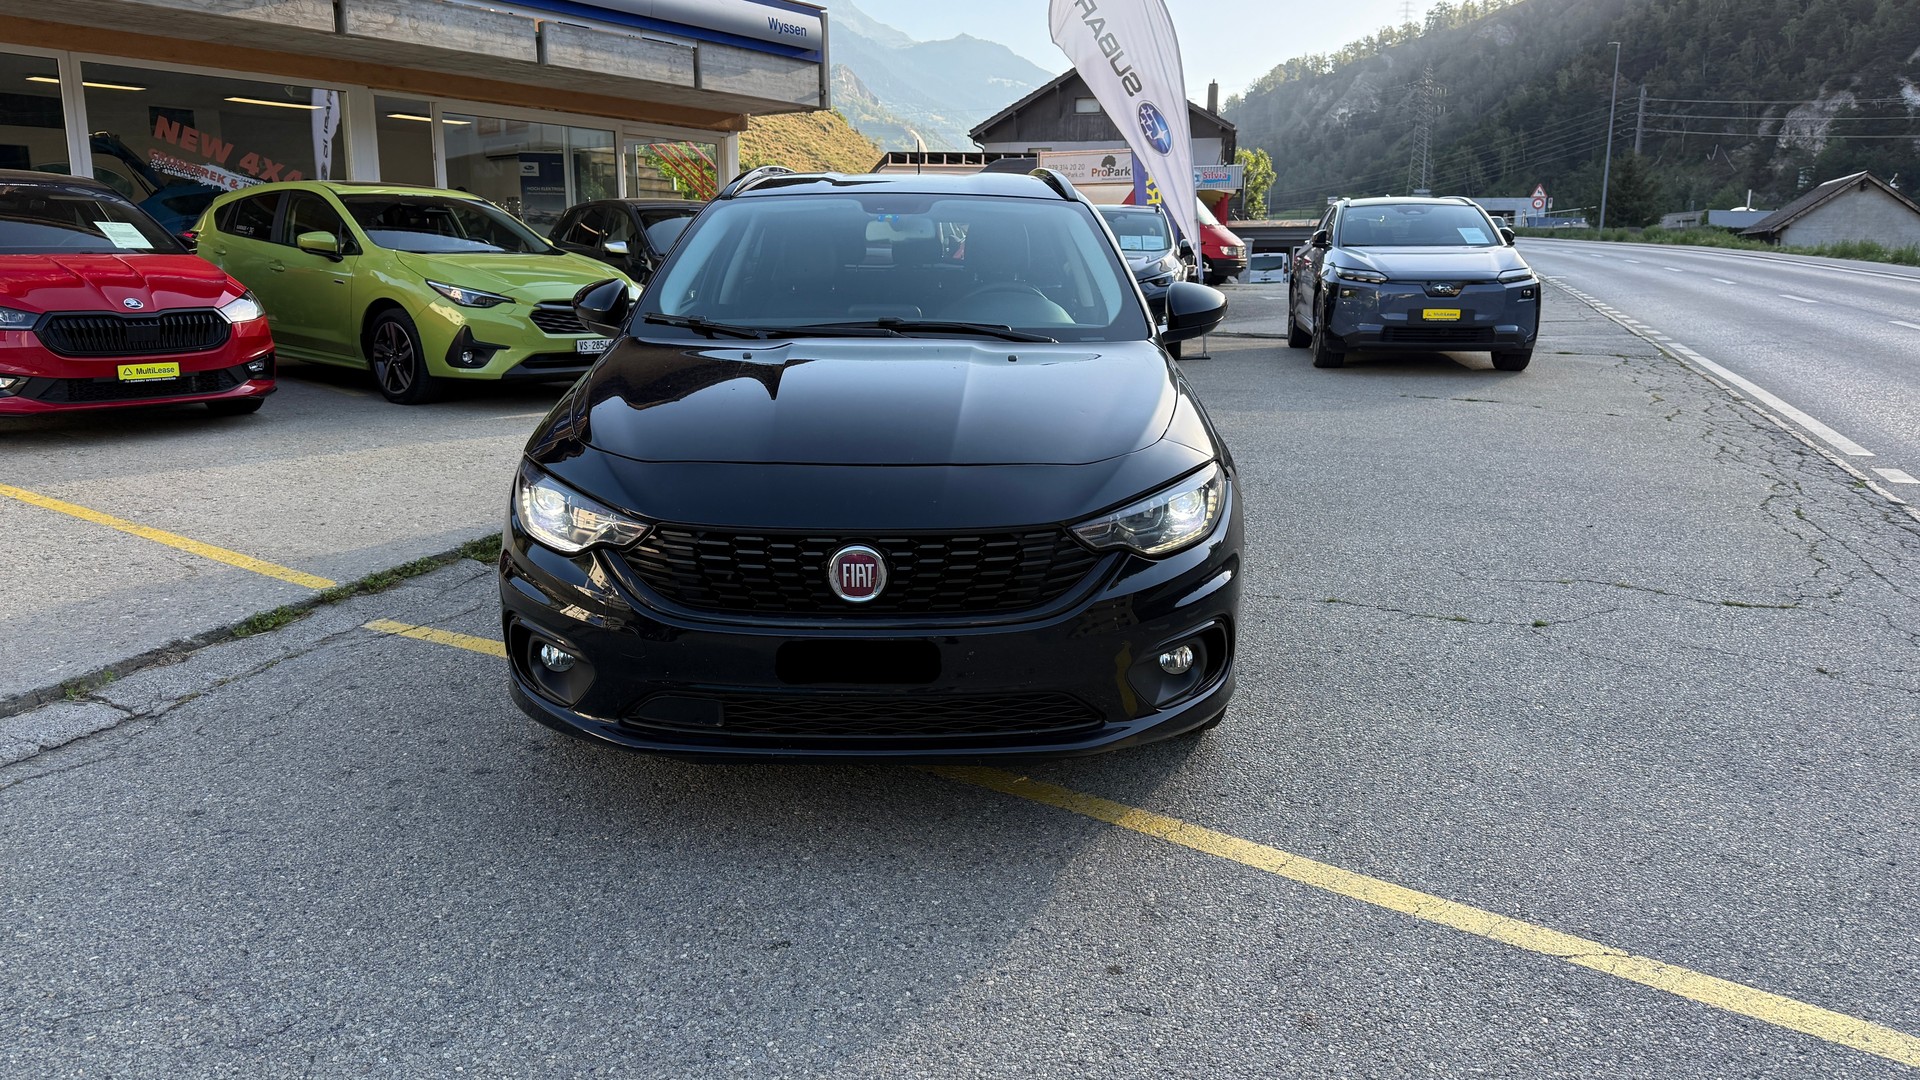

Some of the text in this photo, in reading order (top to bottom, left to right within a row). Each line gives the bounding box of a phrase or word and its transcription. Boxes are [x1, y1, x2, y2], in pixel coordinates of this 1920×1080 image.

[768, 16, 807, 37] Wyssen
[154, 114, 234, 164] NEW
[1077, 163, 1086, 171] 20
[1091, 165, 1131, 177] ProPark
[229, 178, 239, 189] &
[136, 367, 175, 375] MultiLease
[842, 563, 875, 588] FIAT
